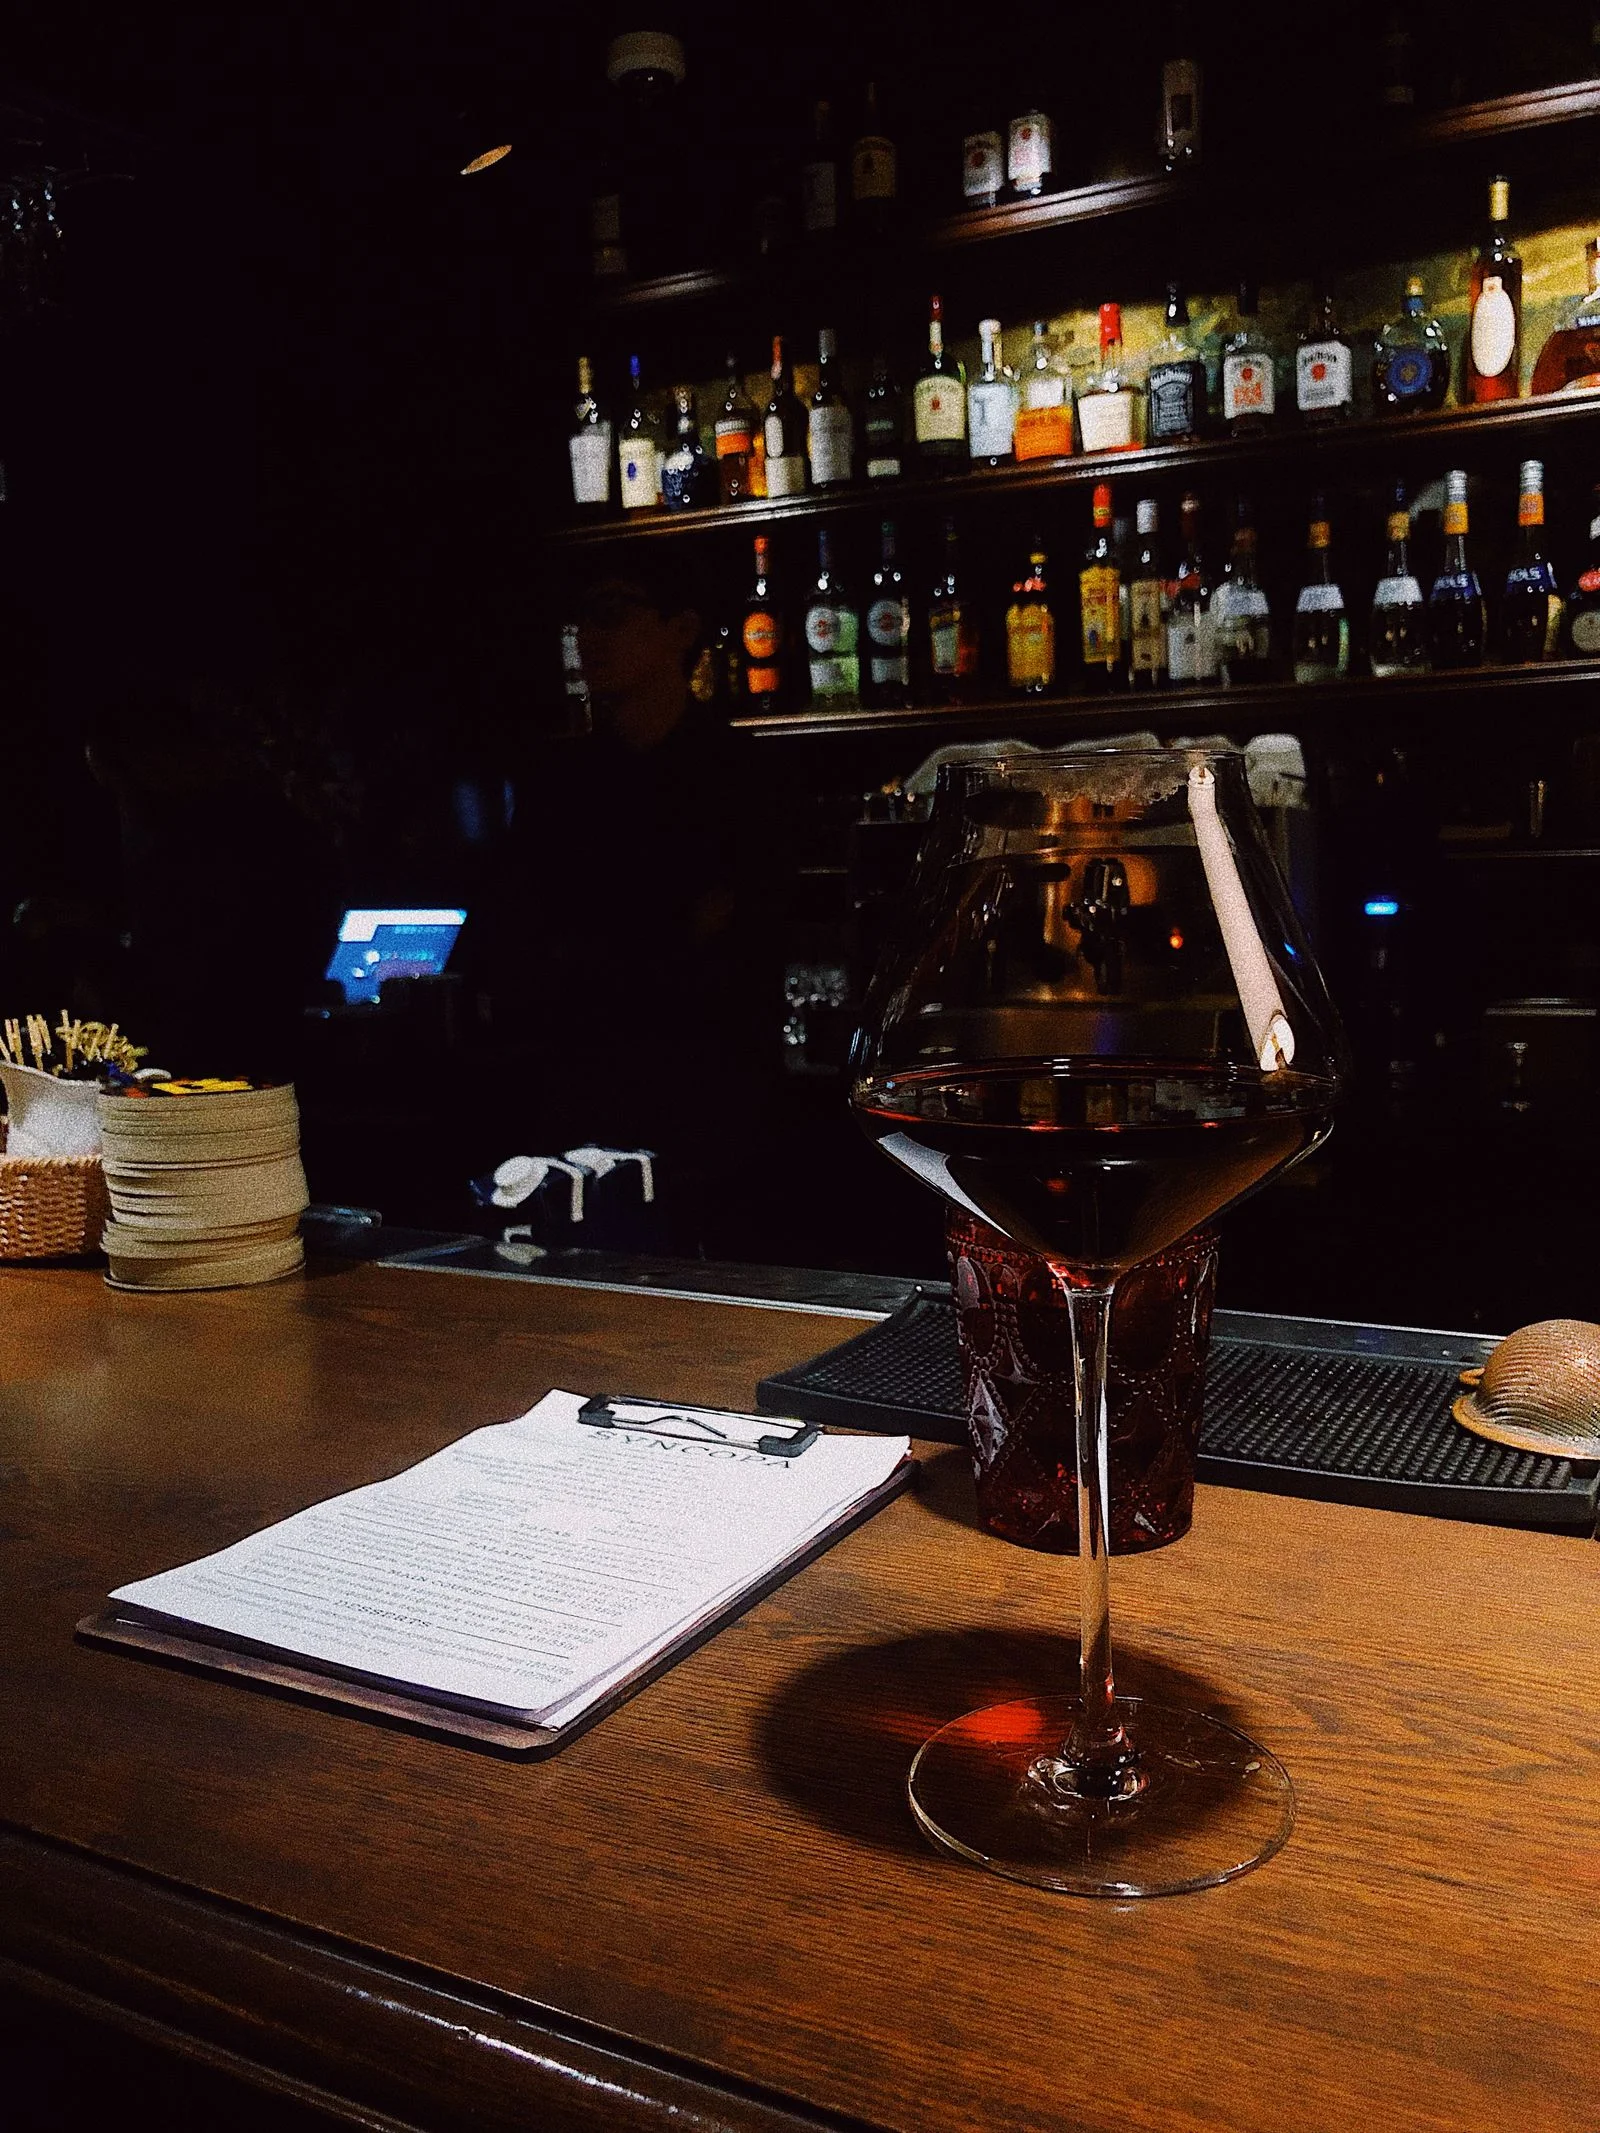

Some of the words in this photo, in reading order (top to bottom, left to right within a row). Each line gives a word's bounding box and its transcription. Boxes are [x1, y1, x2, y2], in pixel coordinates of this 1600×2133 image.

[587, 1430, 790, 1469] SYNCOPA
[466, 1541, 535, 1561] SALADS
[391, 1569, 427, 1582] MAIN
[334, 1599, 432, 1628] DESSERTS
